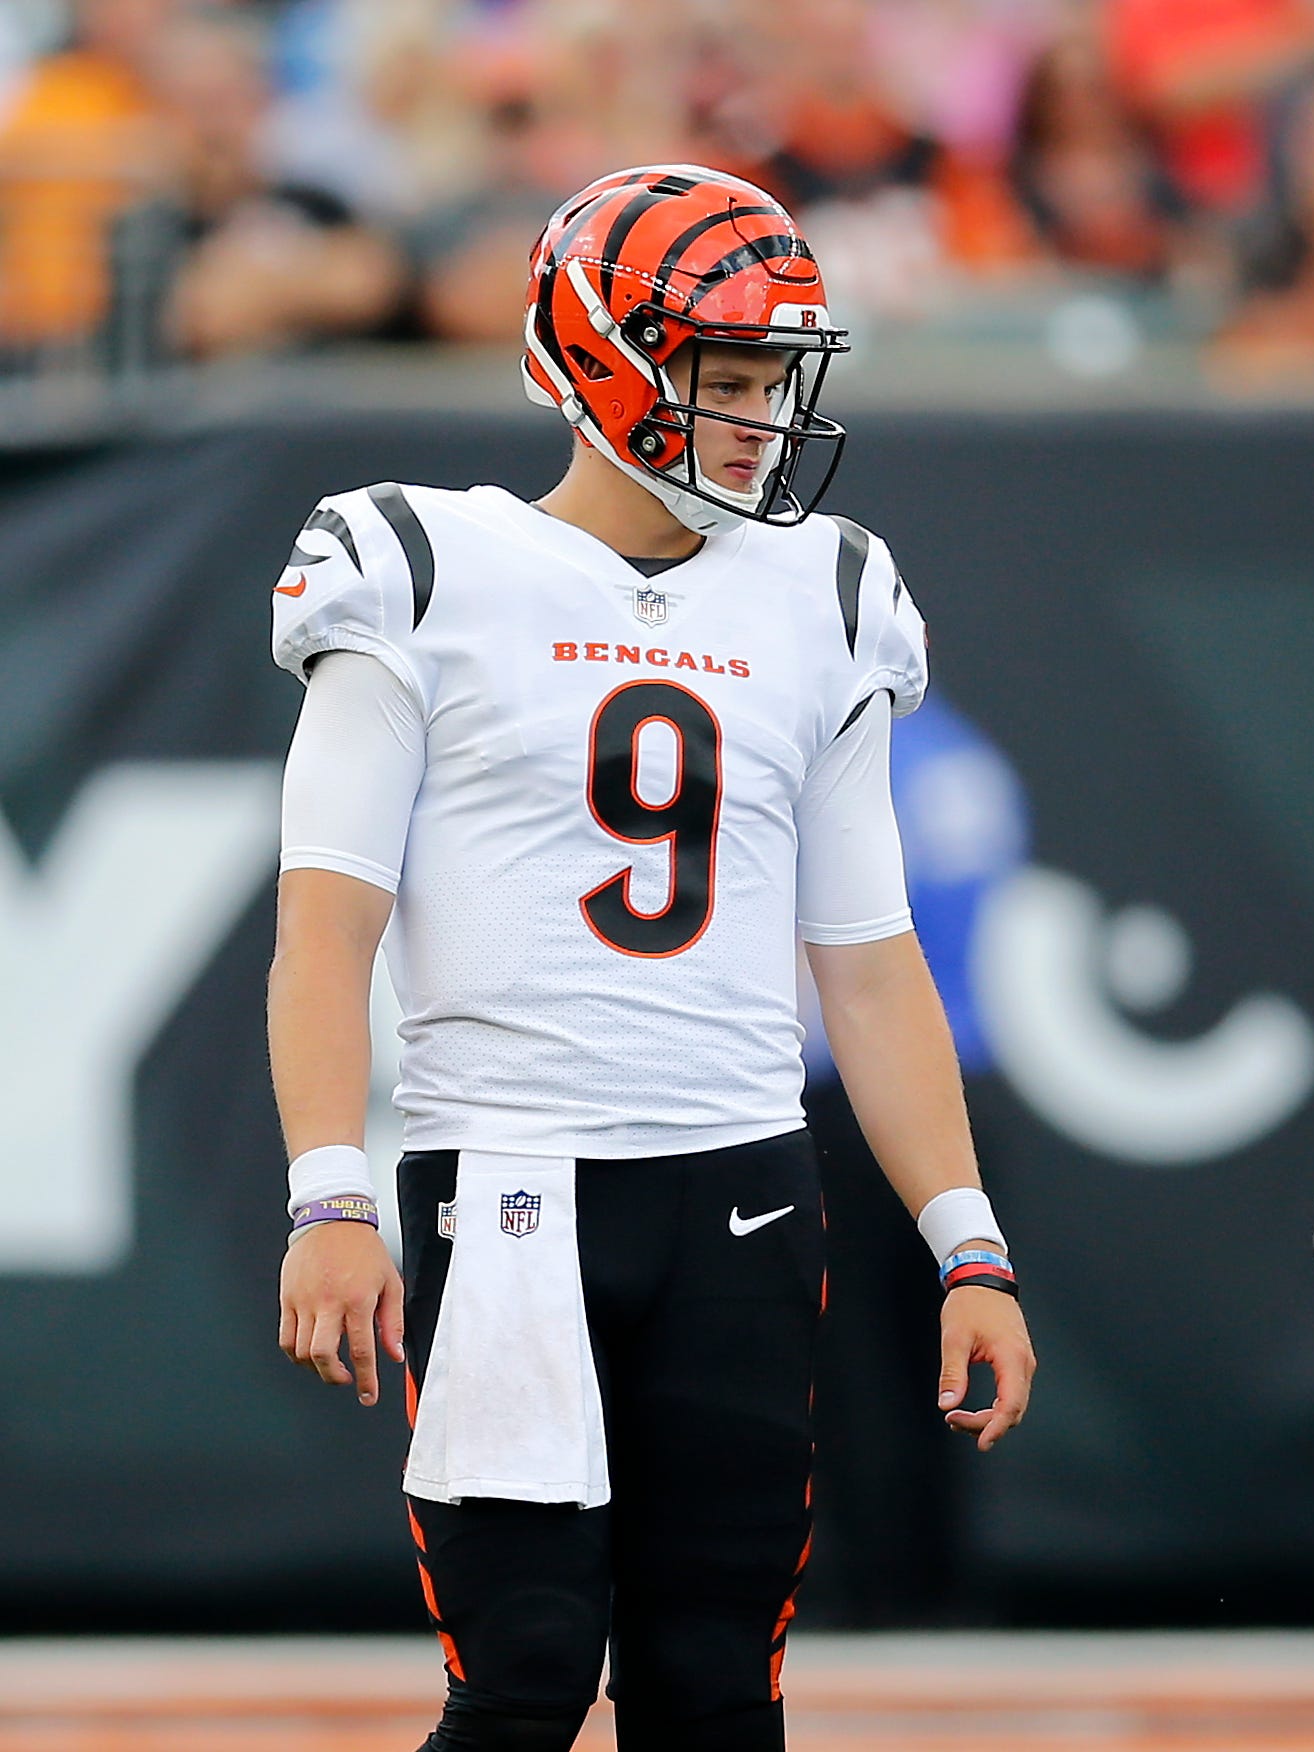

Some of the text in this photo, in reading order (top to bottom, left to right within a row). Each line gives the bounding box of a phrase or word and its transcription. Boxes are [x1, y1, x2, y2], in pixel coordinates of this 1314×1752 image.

[801, 310, 816, 328] B
[640, 601, 664, 619] NFL
[552, 641, 750, 678] BENGALS
[579, 678, 723, 959] 9
[503, 1210, 536, 1233] NFL
